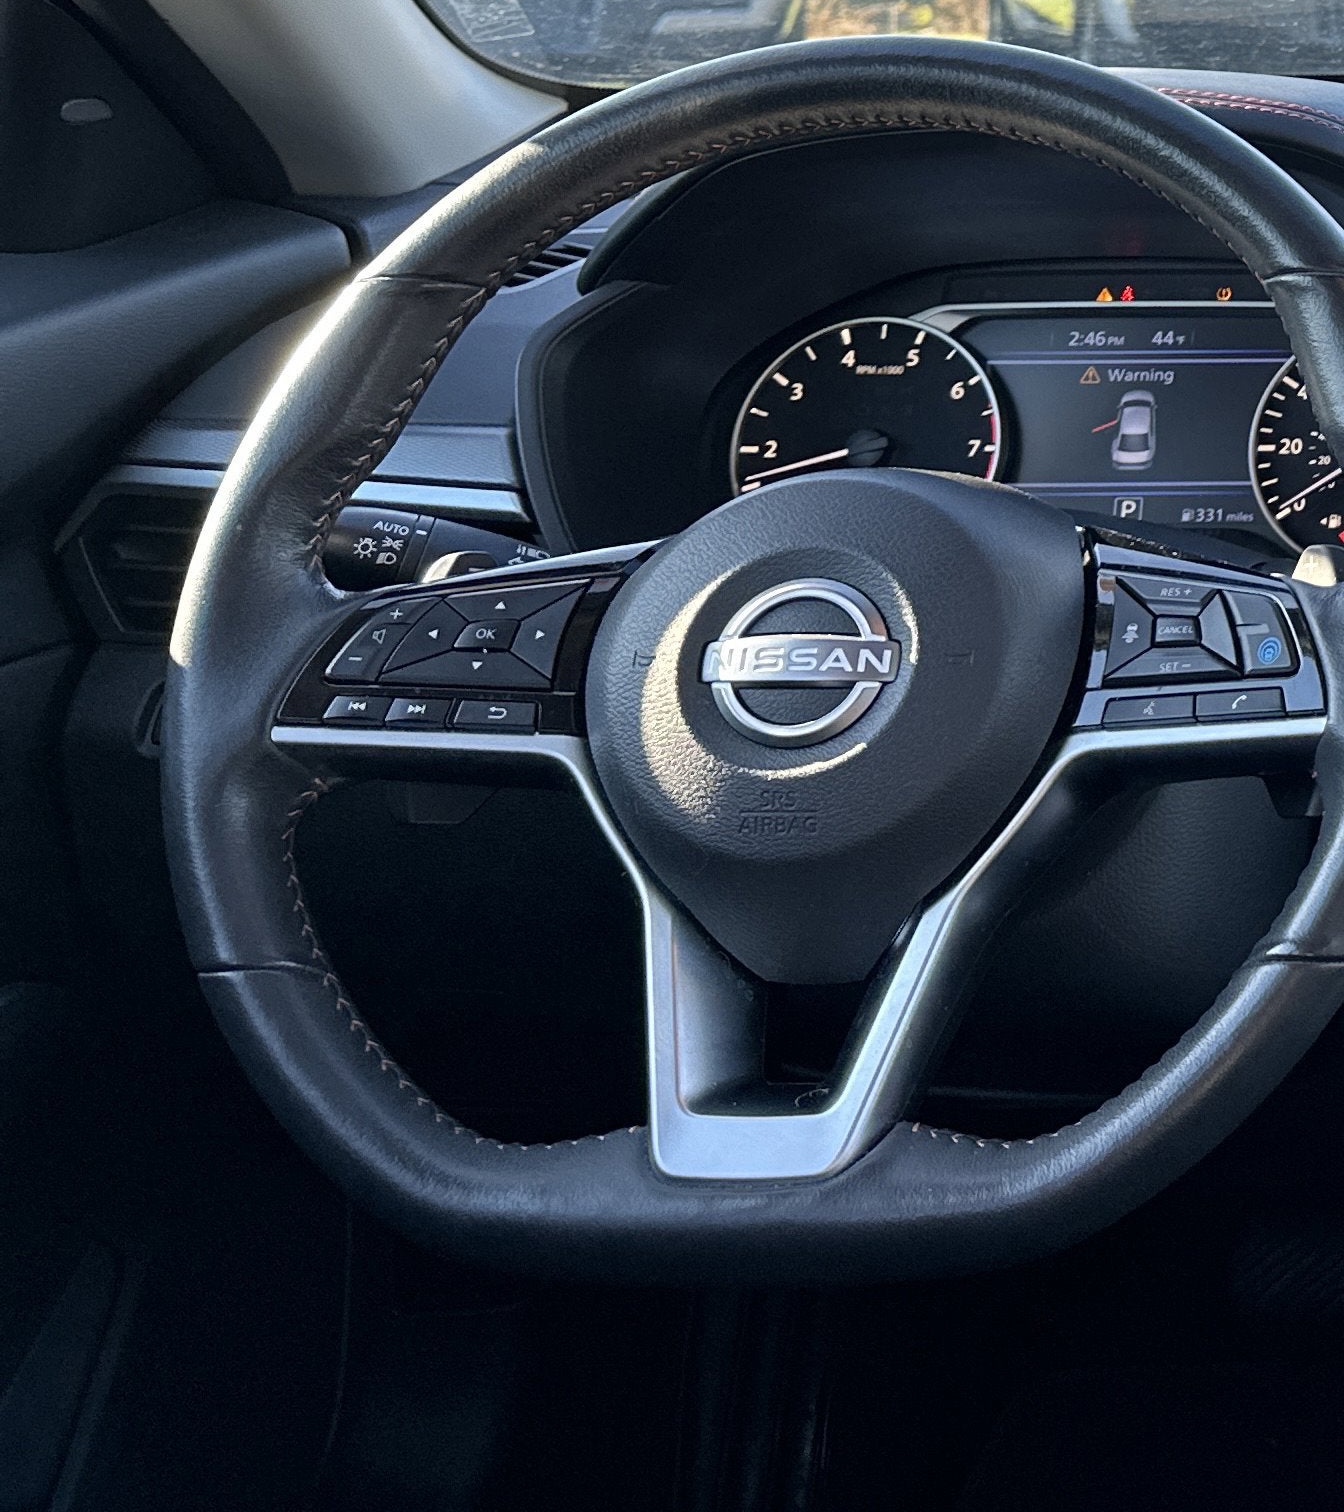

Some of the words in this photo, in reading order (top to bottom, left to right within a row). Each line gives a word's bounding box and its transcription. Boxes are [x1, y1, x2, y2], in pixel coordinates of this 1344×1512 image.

[840, 350, 856, 367] 4
[906, 349, 920, 367] 5
[856, 365, 876, 375] RPM
[1107, 368, 1175, 385] Warning
[790, 383, 804, 401] 3
[950, 381, 965, 400] 6
[763, 440, 778, 458] 2
[968, 440, 981, 457] 7
[1278, 439, 1303, 454] 20
[1318, 456, 1331, 465] 20
[1120, 500, 1137, 518] P
[1195, 508, 1223, 523] 331
[1226, 511, 1254, 523] miles
[373, 520, 410, 537] AUTO
[1160, 588, 1181, 597] RES
[475, 628, 497, 640] OK
[1158, 626, 1194, 635] CANCEL
[706, 647, 893, 674] NISSAN
[1159, 662, 1178, 671] SET
[759, 791, 797, 810] SRS
[738, 817, 818, 835] AIRBAG
